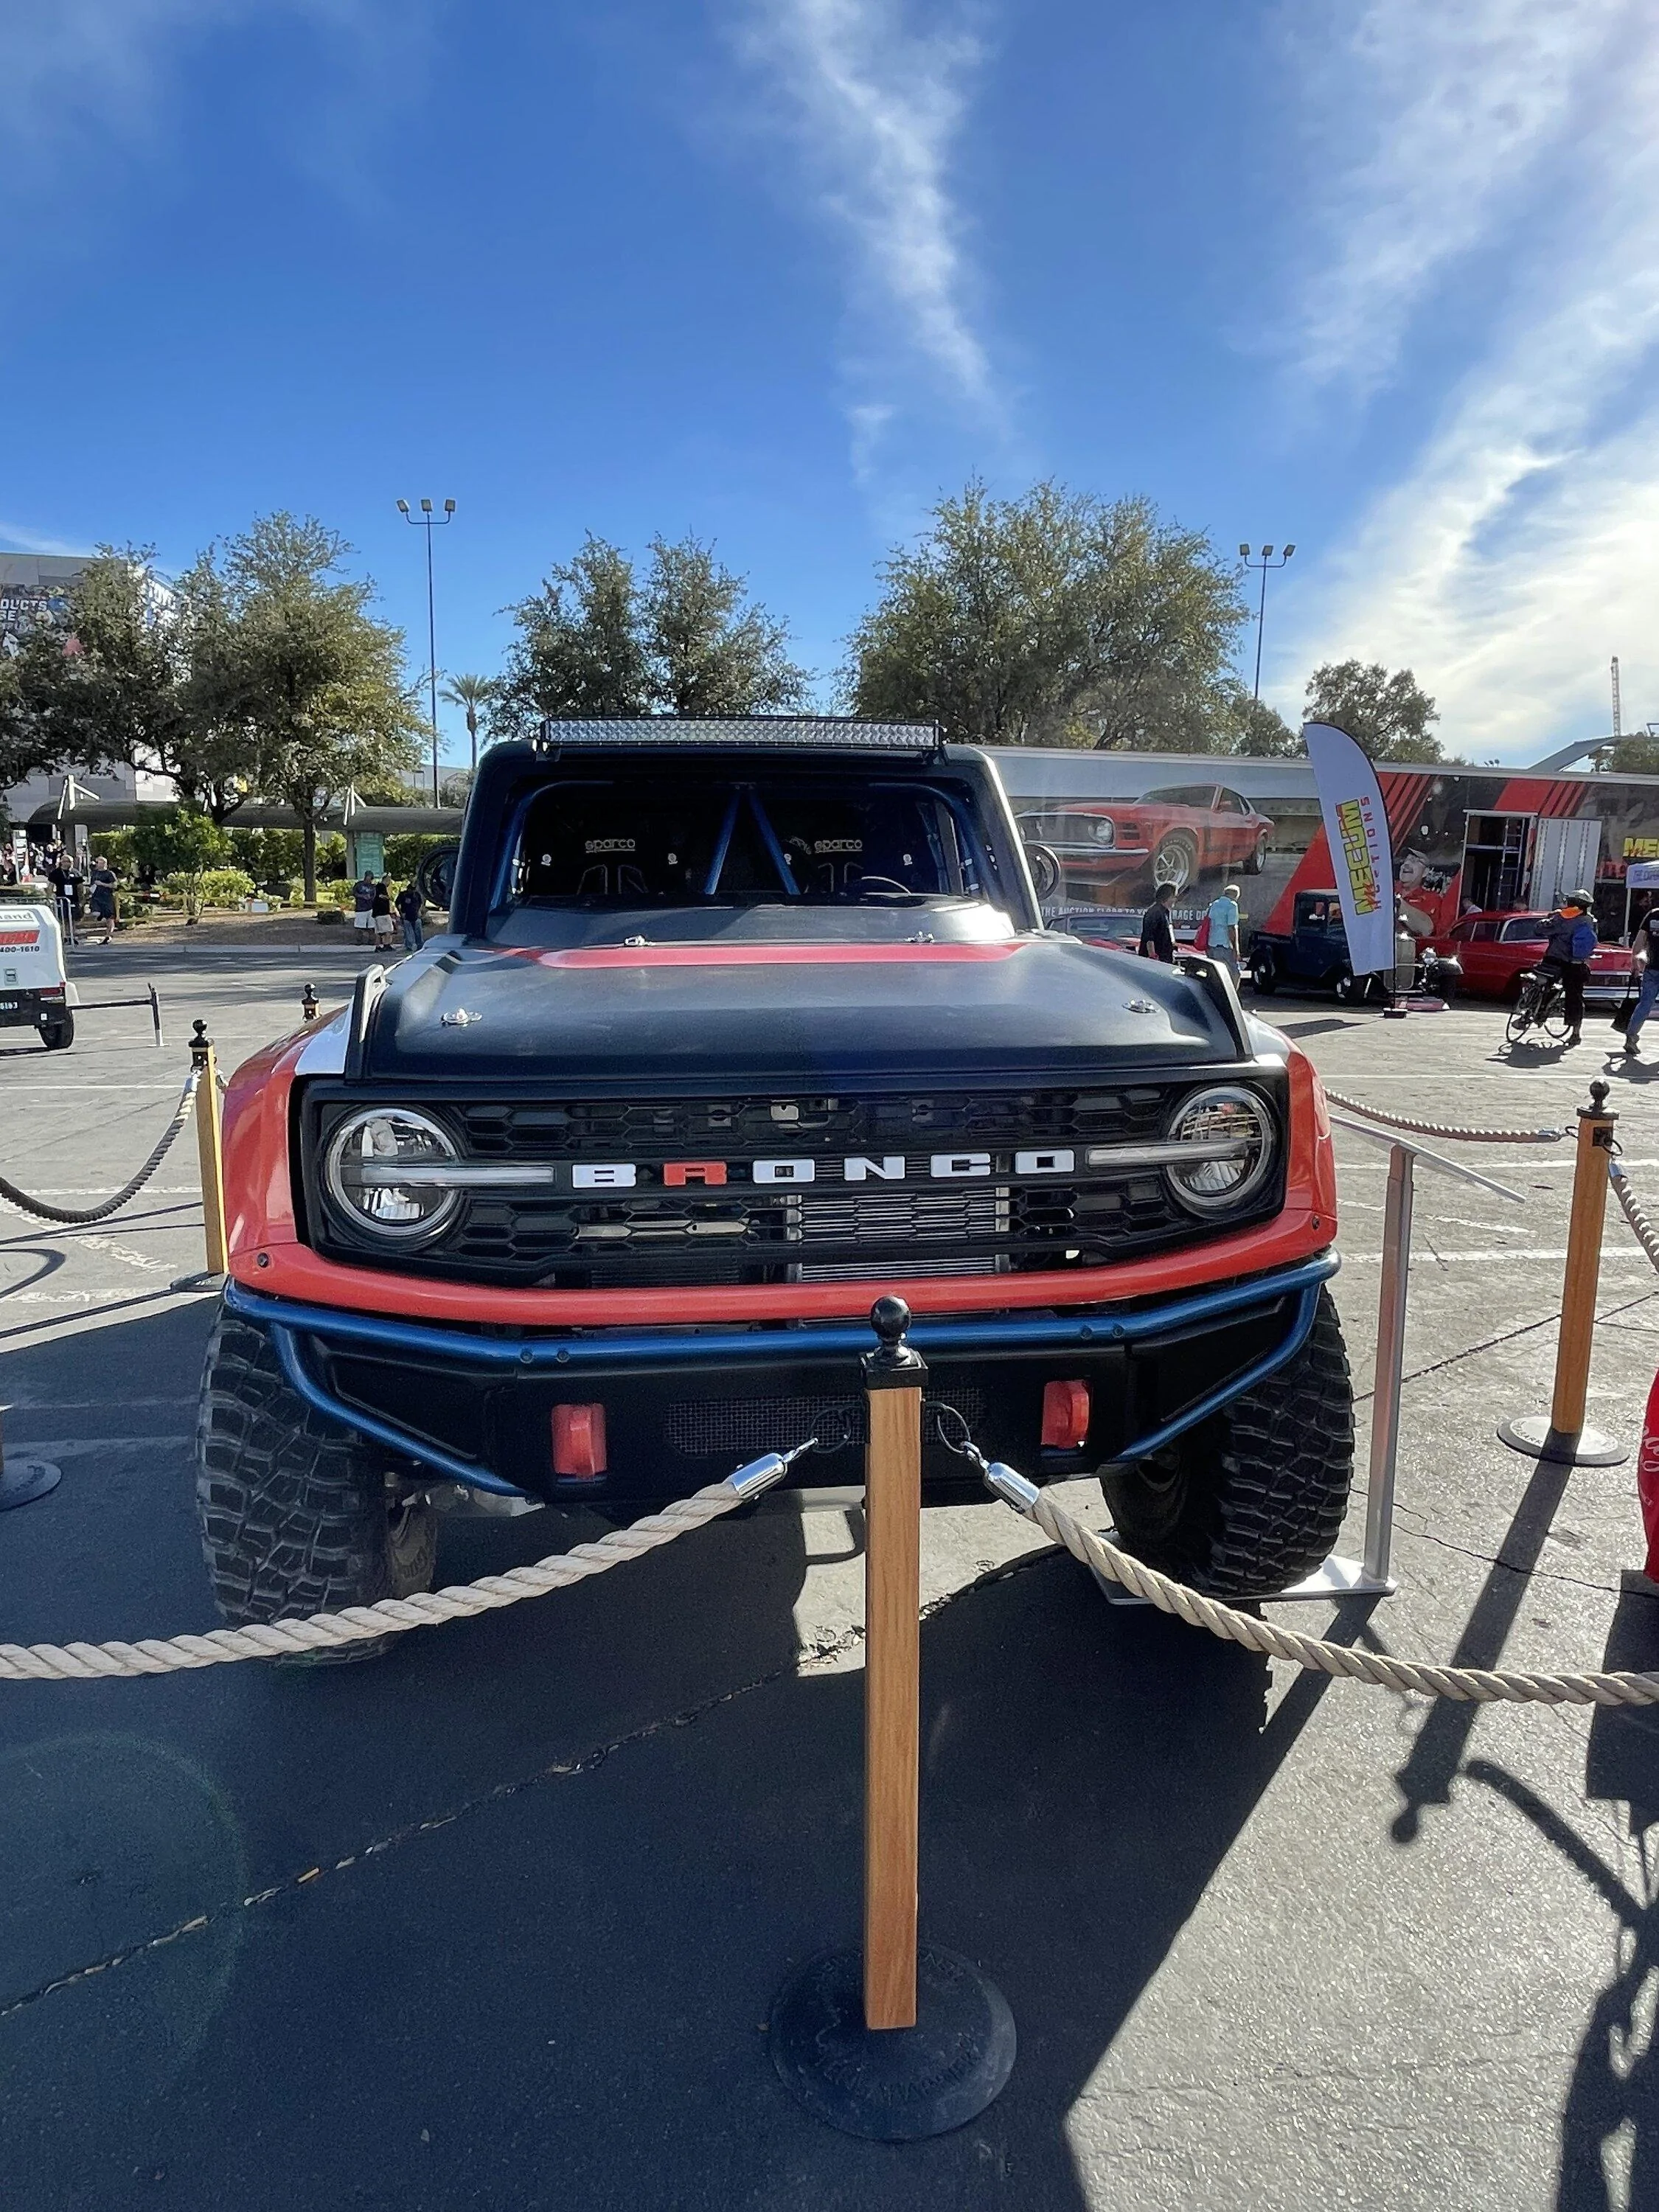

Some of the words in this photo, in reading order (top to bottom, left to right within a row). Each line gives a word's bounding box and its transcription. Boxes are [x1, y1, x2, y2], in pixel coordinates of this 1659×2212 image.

[585, 838, 636, 853] sparco
[814, 839, 863, 853] sparco
[1622, 838, 1659, 858] ME
[1335, 799, 1375, 915] MECUM
[1041, 906, 1056, 917] THE
[1172, 910, 1193, 921] RAGE
[571, 1149, 1075, 1189] BRONCO
